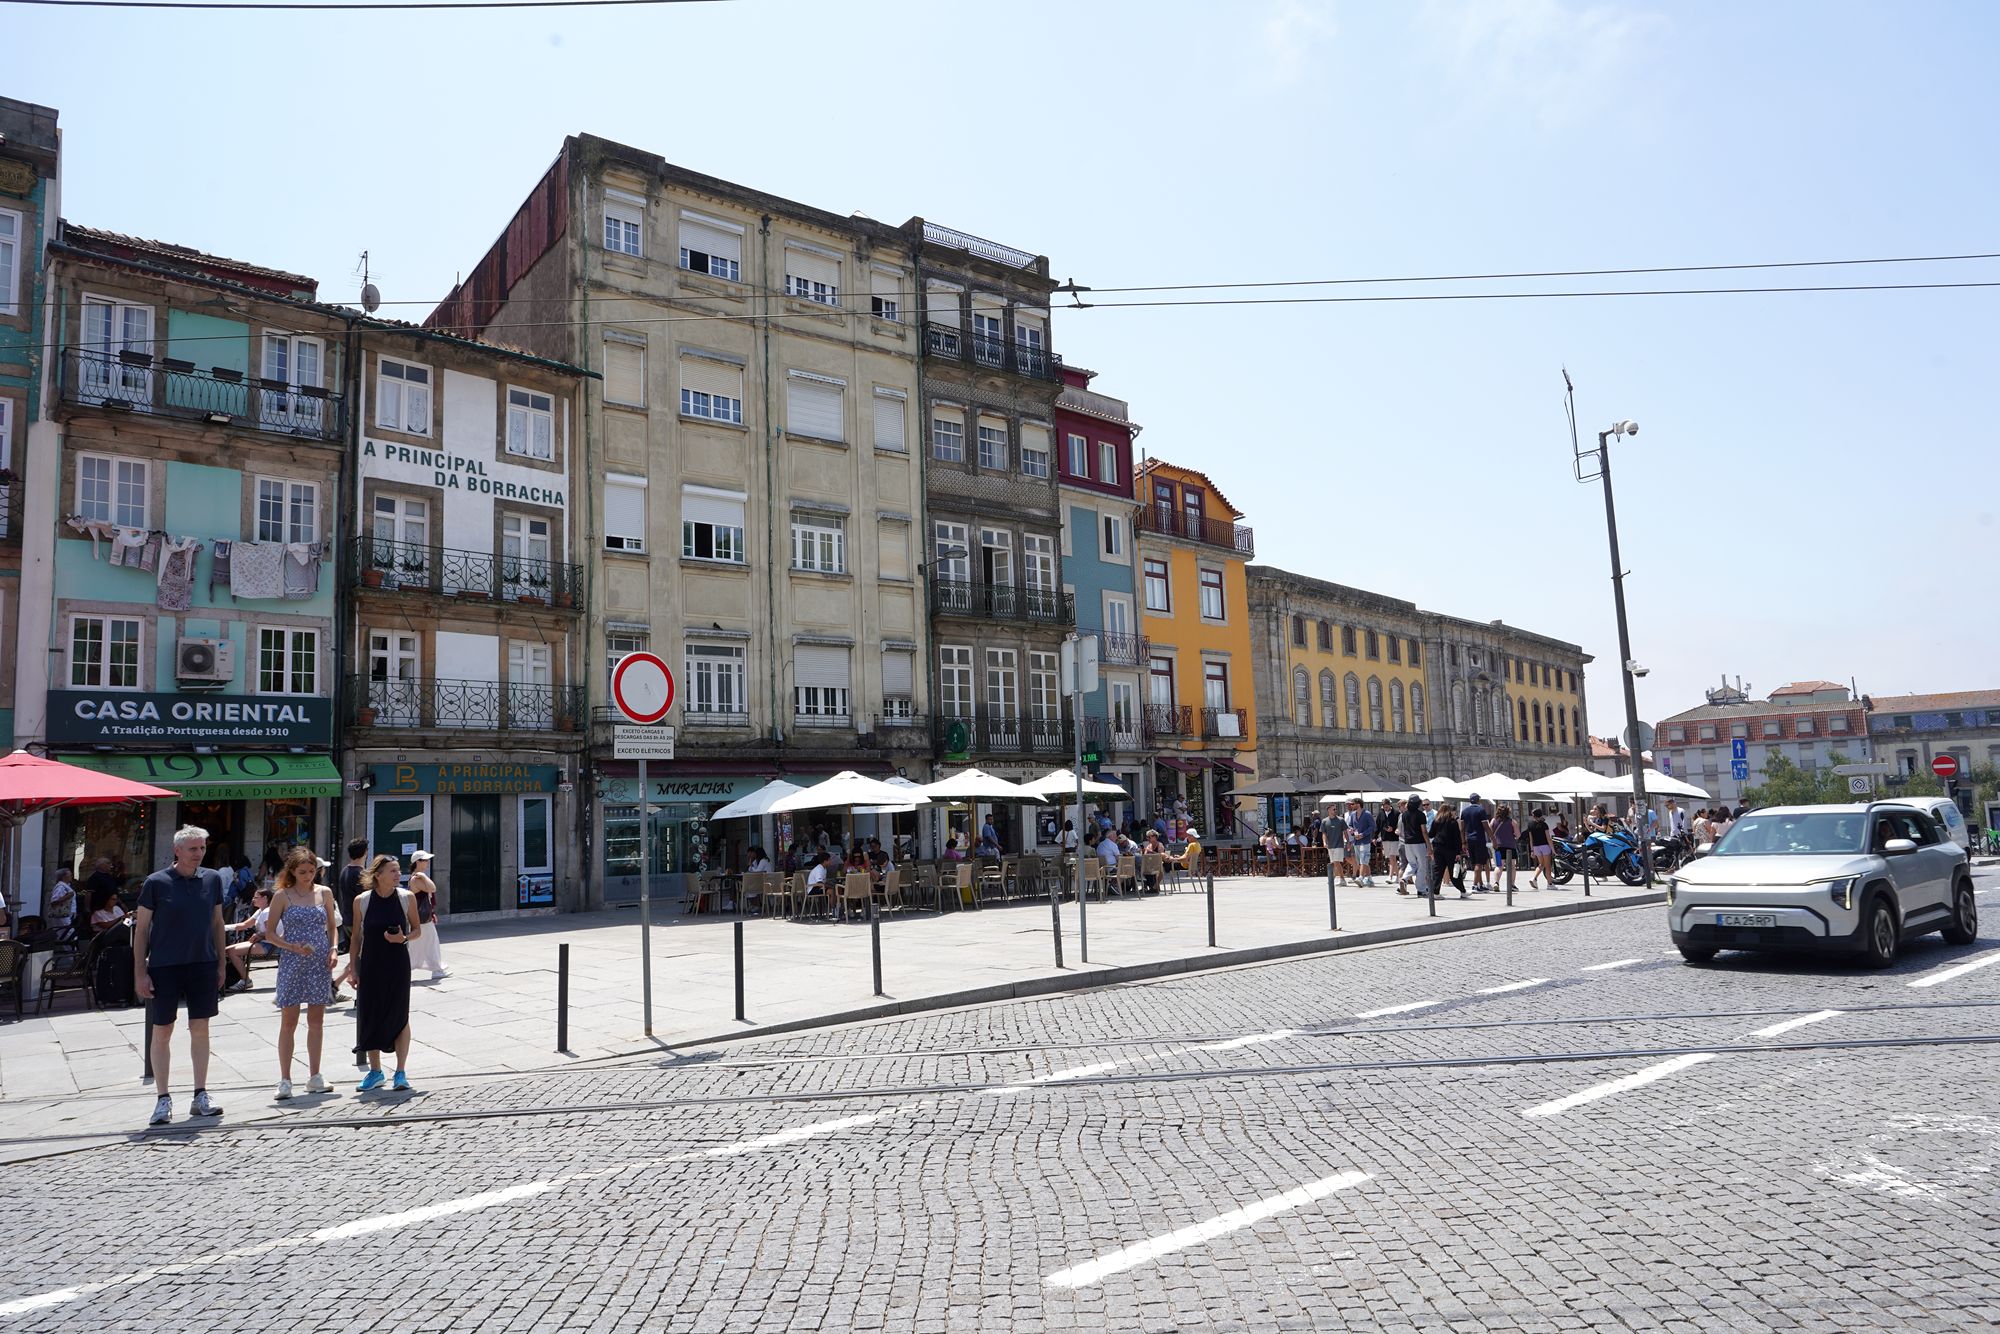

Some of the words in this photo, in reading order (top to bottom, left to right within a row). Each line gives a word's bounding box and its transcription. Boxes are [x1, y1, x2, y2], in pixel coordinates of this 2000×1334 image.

[364, 441, 377, 457] A
[385, 444, 488, 477] PRINCIPAL
[435, 471, 460, 489] DA
[467, 476, 565, 506] BORRACHA
[74, 699, 161, 721] CASA
[171, 701, 311, 724] ORIENTAL
[100, 726, 110, 735] A
[112, 725, 164, 737] Tradição
[166, 727, 231, 737] Portuguesa
[232, 727, 263, 736] desde
[265, 727, 289, 737] 1910
[143, 754, 280, 779] 1910
[438, 766, 447, 777] A
[453, 766, 530, 778] PRINCIPAL
[253, 786, 273, 796] DO
[280, 785, 328, 797] PORTO
[437, 781, 457, 793] DA
[463, 781, 543, 793] BORRACHA
[657, 782, 733, 797] MURALHAS
[1725, 916, 1741, 926] CA
[1742, 916, 1754, 926] 25
